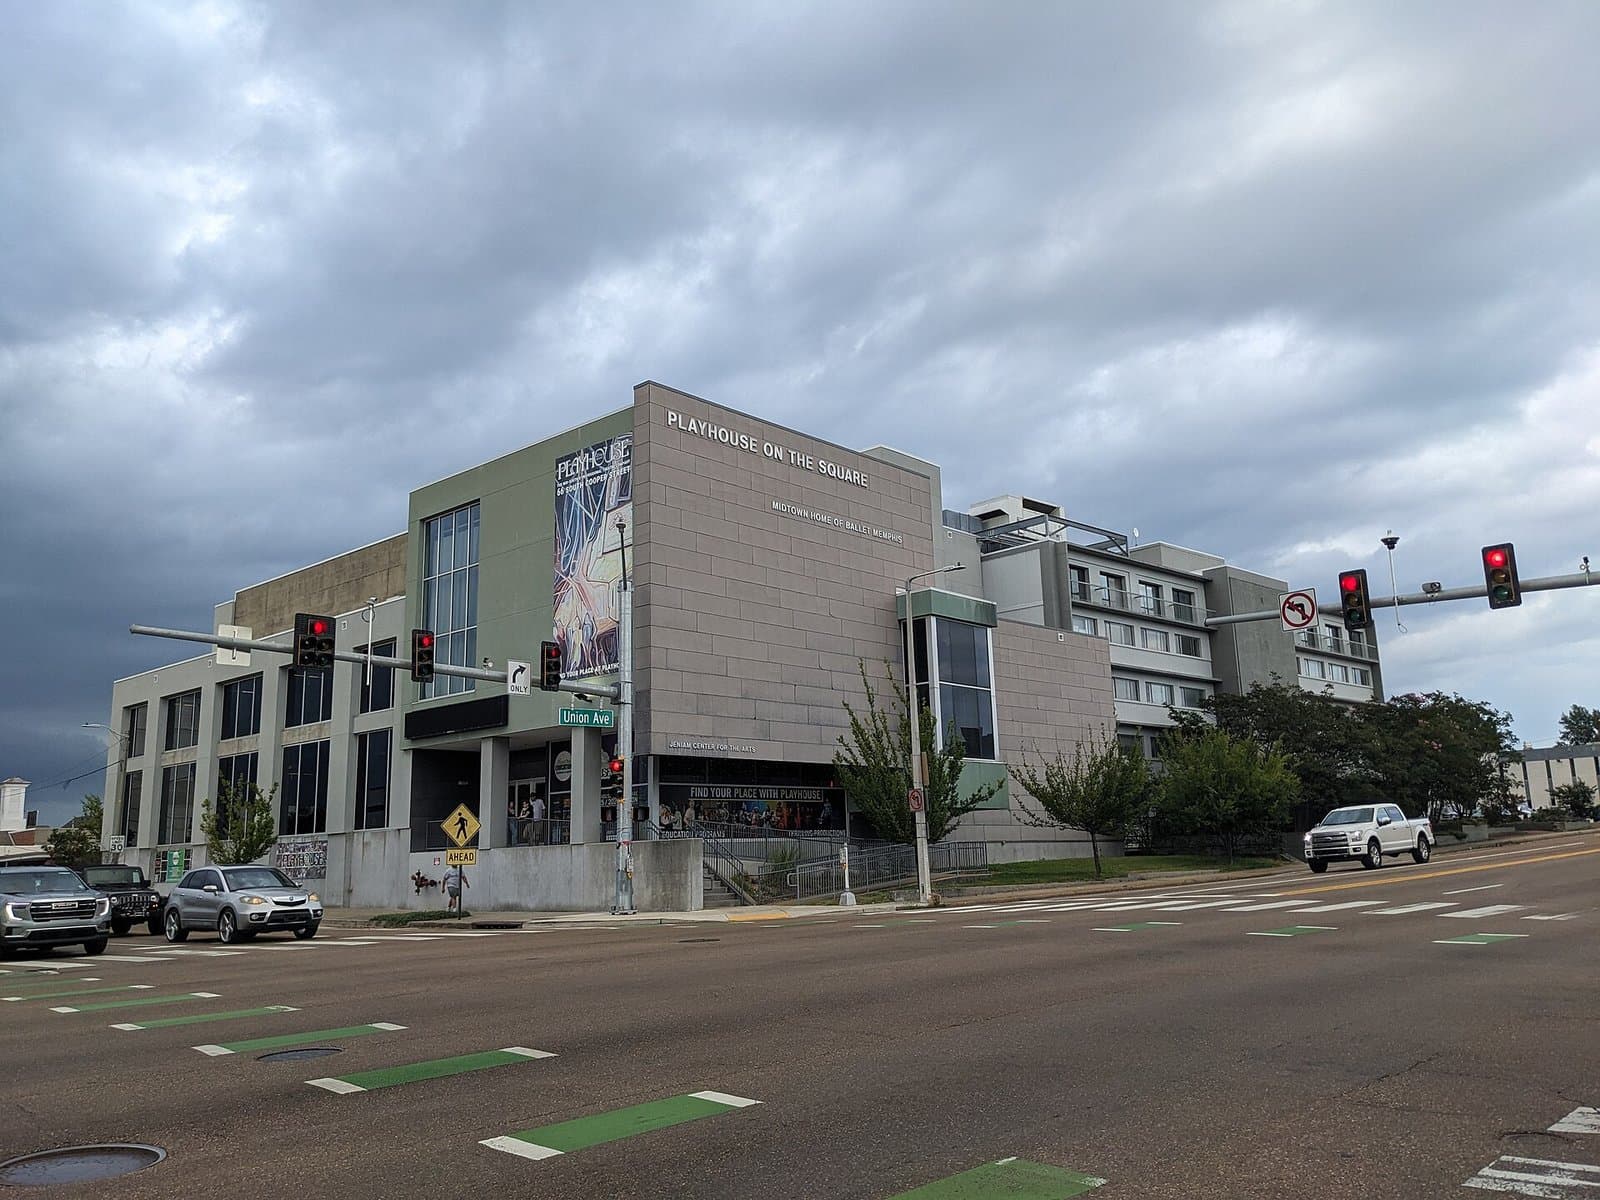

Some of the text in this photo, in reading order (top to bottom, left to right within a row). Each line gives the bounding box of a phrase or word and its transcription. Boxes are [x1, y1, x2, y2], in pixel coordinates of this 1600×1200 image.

[667, 410, 869, 488] PLAYHOUSE ON THE SQUARE
[558, 439, 630, 480] PLAYHOUSE
[556, 486, 565, 497] 66
[566, 482, 584, 494] SOUTH
[585, 473, 607, 487] COOPER
[608, 465, 631, 479] STREET
[772, 500, 903, 544] MIDTOWN HOME OF BALLET MEMPHIS
[510, 684, 528, 693] ONLY
[563, 710, 610, 725] Union Ave
[692, 742, 715, 751] CENTER
[716, 743, 728, 752] FOR
[729, 744, 740, 752] THE
[741, 745, 756, 753] ARTS
[690, 786, 821, 799] FIND YOUR PLACE WITH PLAYHOUSE
[448, 852, 474, 861] AHEAD
